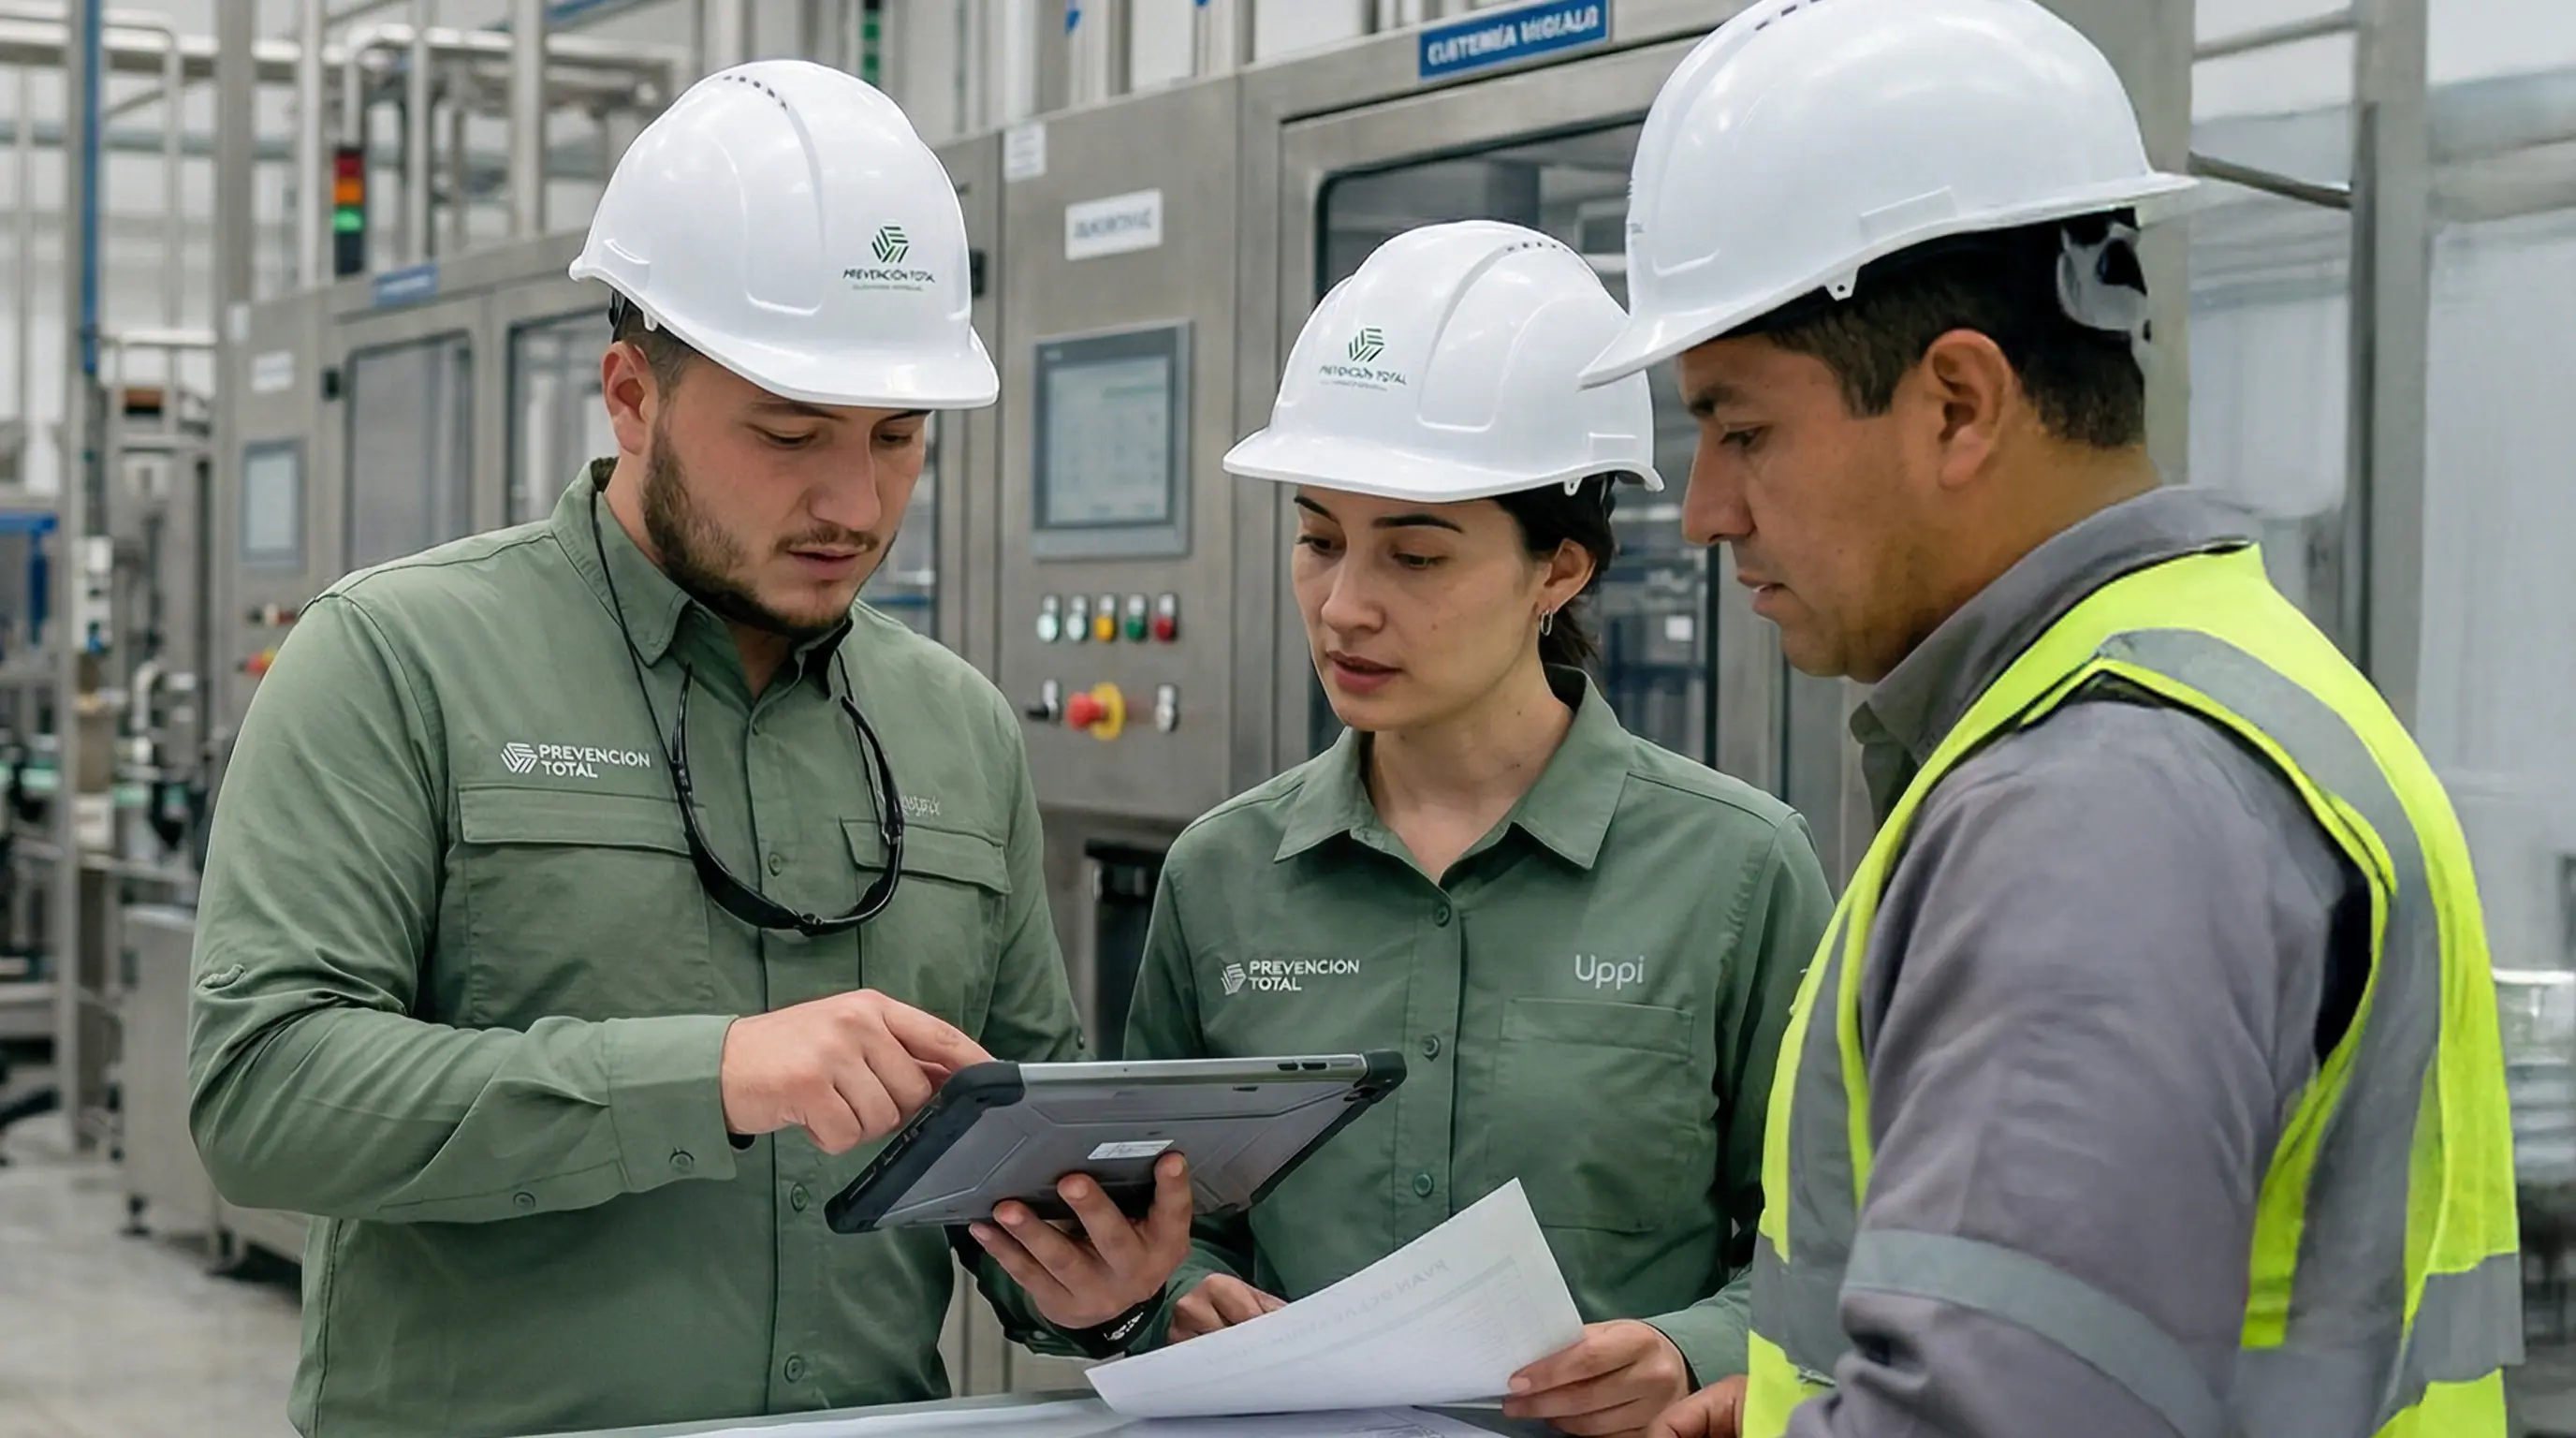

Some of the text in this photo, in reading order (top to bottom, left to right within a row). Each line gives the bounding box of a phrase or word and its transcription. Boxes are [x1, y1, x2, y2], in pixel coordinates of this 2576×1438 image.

[538, 743, 651, 768] PREVENCION
[540, 759, 598, 778] TOTAL
[1249, 959, 1360, 975] PREVENCION
[1575, 954, 1645, 990] Uppi
[1248, 976, 1302, 991] TOTAL
